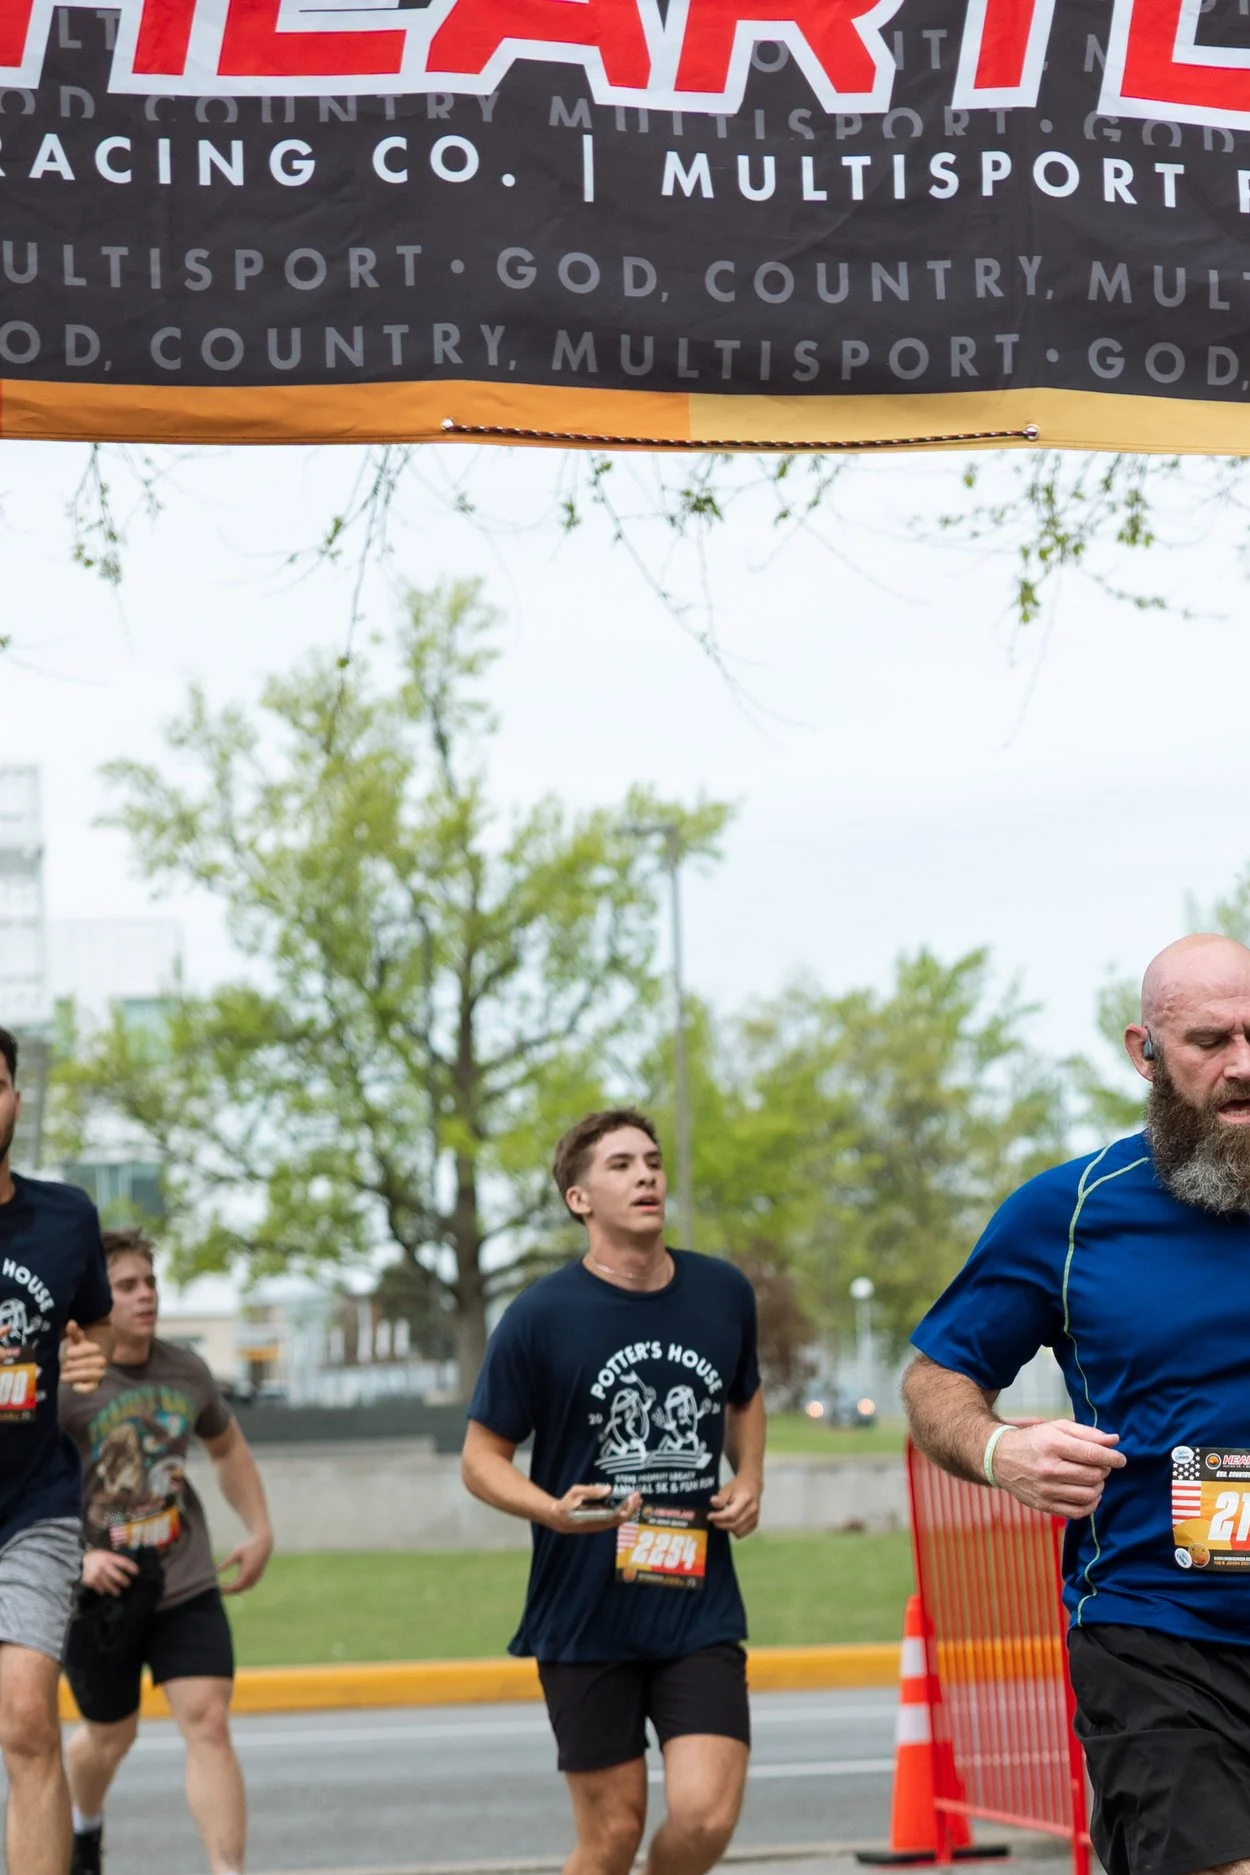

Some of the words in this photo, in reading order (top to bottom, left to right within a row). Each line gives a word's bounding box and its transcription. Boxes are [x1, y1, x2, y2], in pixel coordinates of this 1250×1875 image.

[0, 132, 317, 188] ACING
[371, 134, 517, 188] CO.
[660, 149, 1187, 209] MULTISPORT
[496, 246, 669, 303] GOD,
[704, 255, 1055, 304] COUNTRY,
[148, 322, 518, 373] COUNTRY,
[550, 328, 1020, 383] MULTISPORT
[1086, 336, 1250, 393] GOD,
[2, 1256, 56, 1314] HOUSE
[589, 1340, 663, 1401] POTTER'S
[667, 1342, 724, 1395] HOUSE
